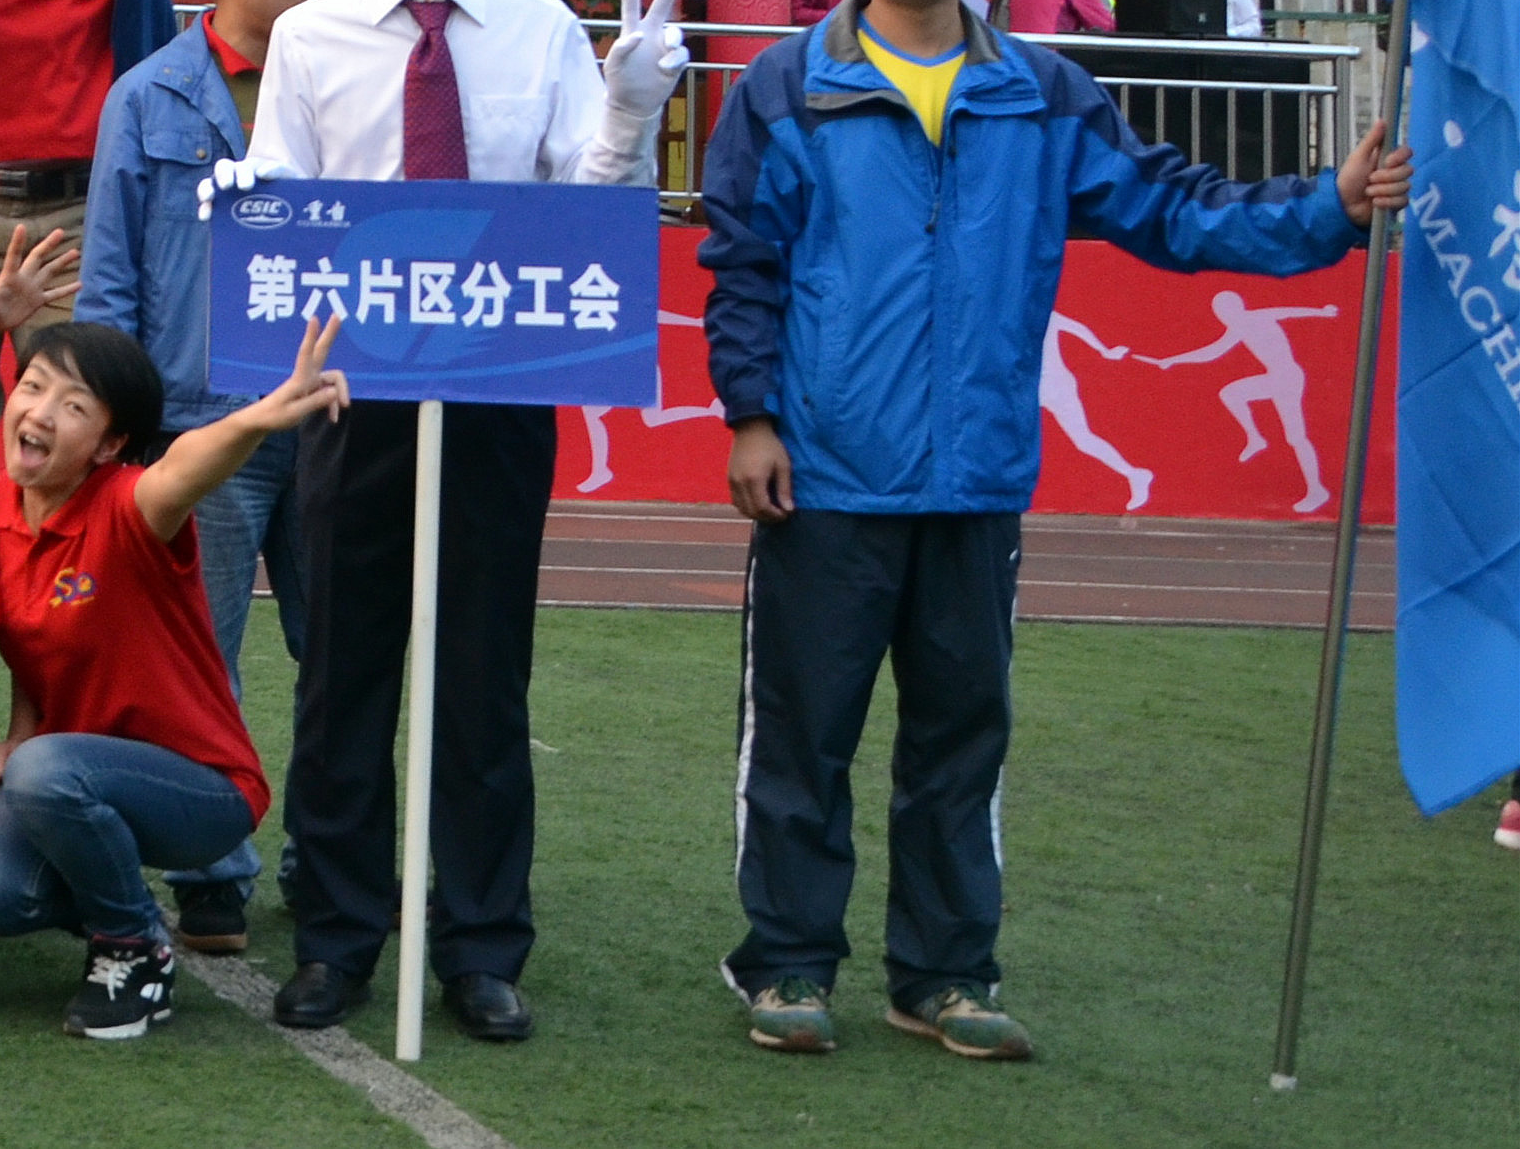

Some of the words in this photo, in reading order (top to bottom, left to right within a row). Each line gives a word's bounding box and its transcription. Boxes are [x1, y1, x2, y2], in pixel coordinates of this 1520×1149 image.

[240, 200, 283, 214] CSIC
[245, 253, 621, 331] 第六片区分工会
